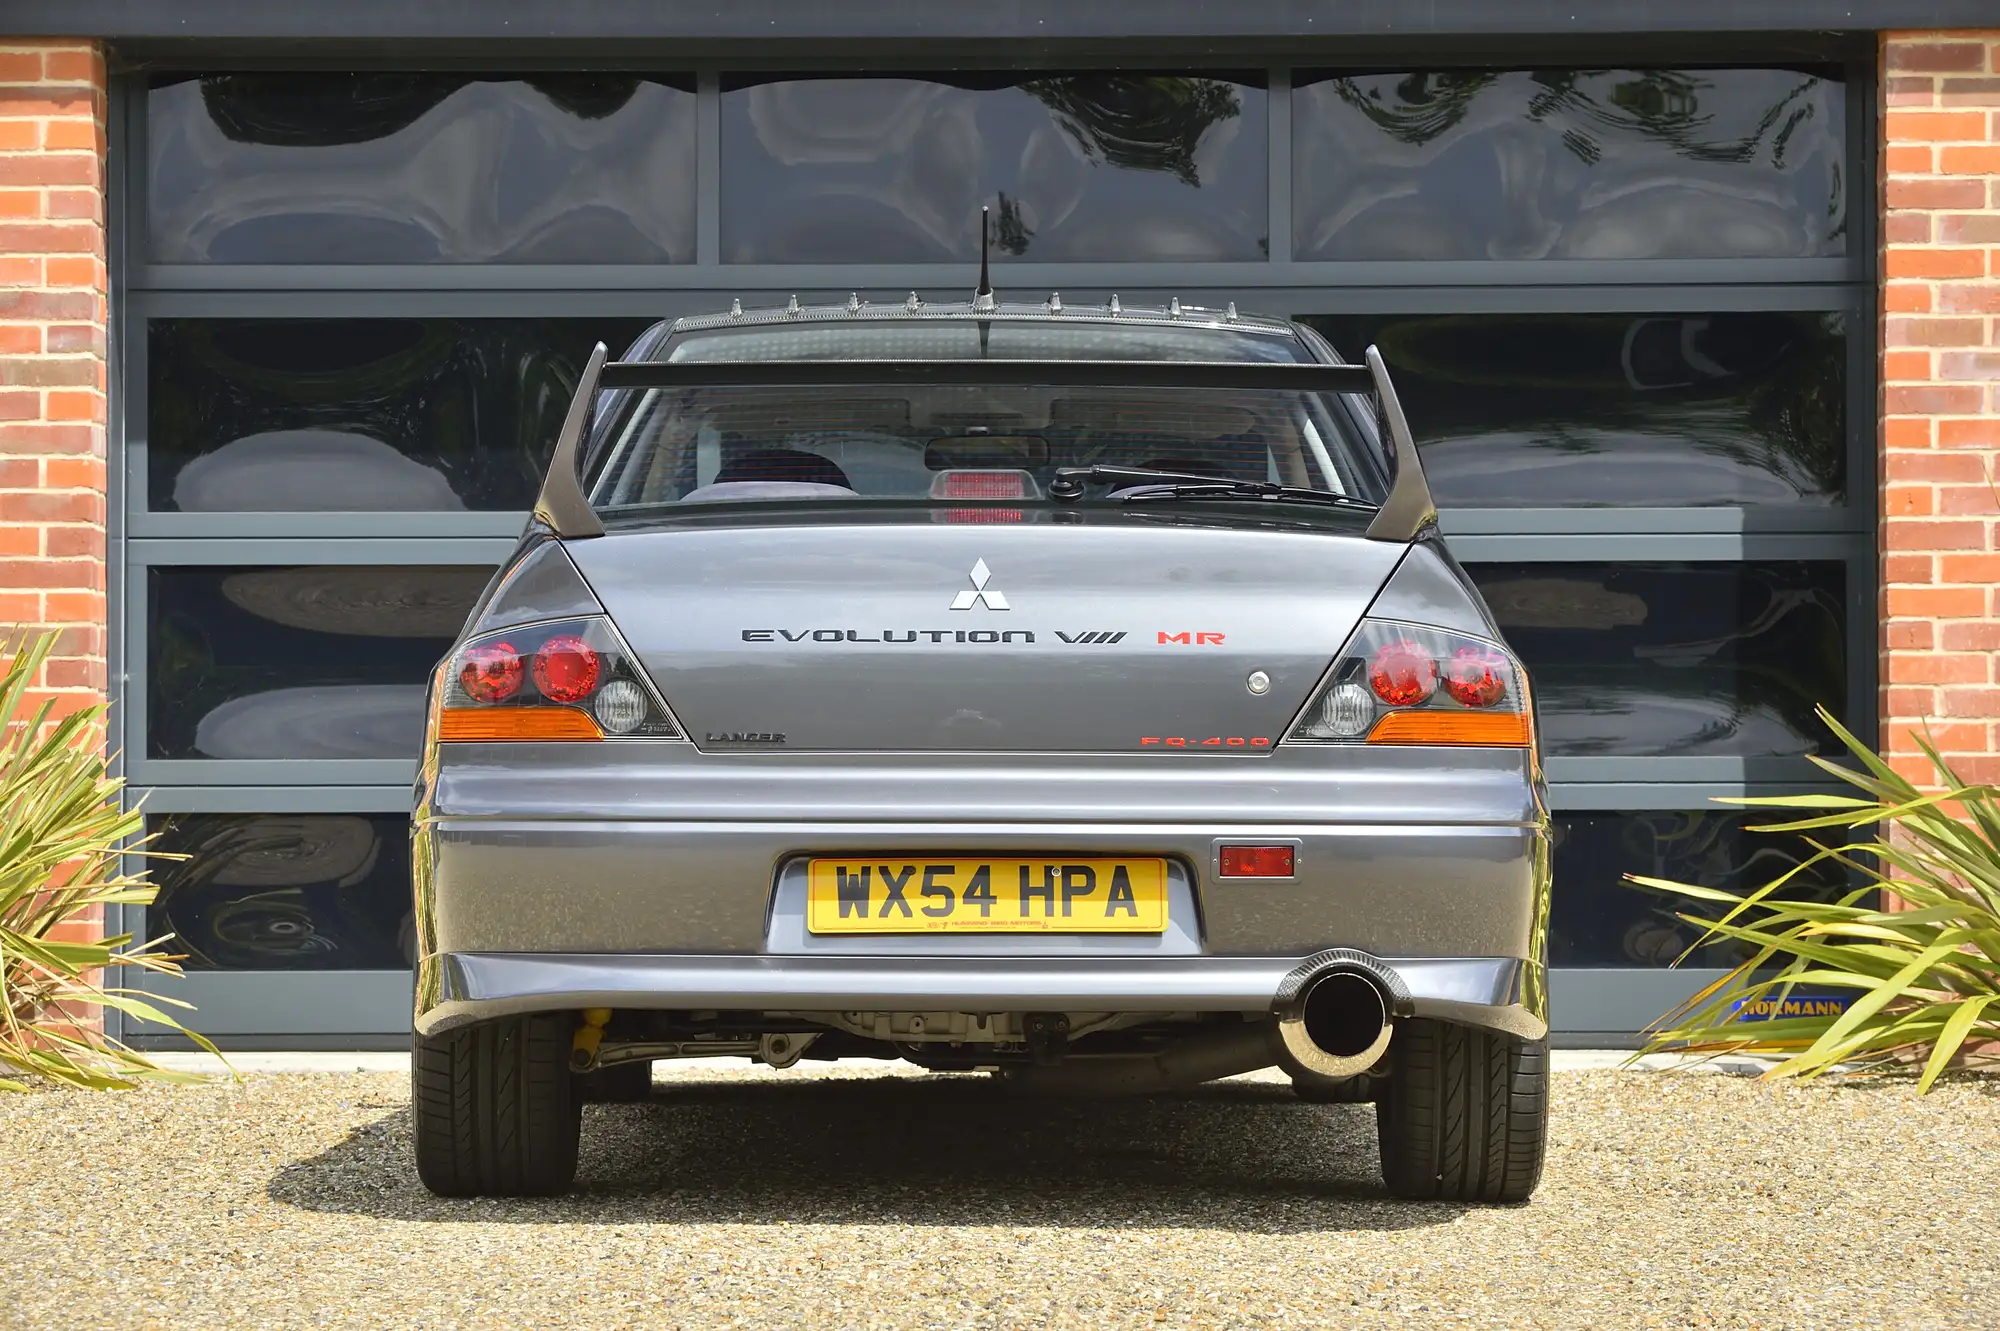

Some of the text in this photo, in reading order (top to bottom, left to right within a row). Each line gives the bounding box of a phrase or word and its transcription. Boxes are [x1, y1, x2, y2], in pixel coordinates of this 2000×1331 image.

[742, 629, 1036, 643] EVOLUTION
[1157, 631, 1226, 645] MR
[706, 732, 787, 743] LANCER
[1141, 736, 1270, 747] FQ-400
[836, 864, 1139, 919] WX54 HPA
